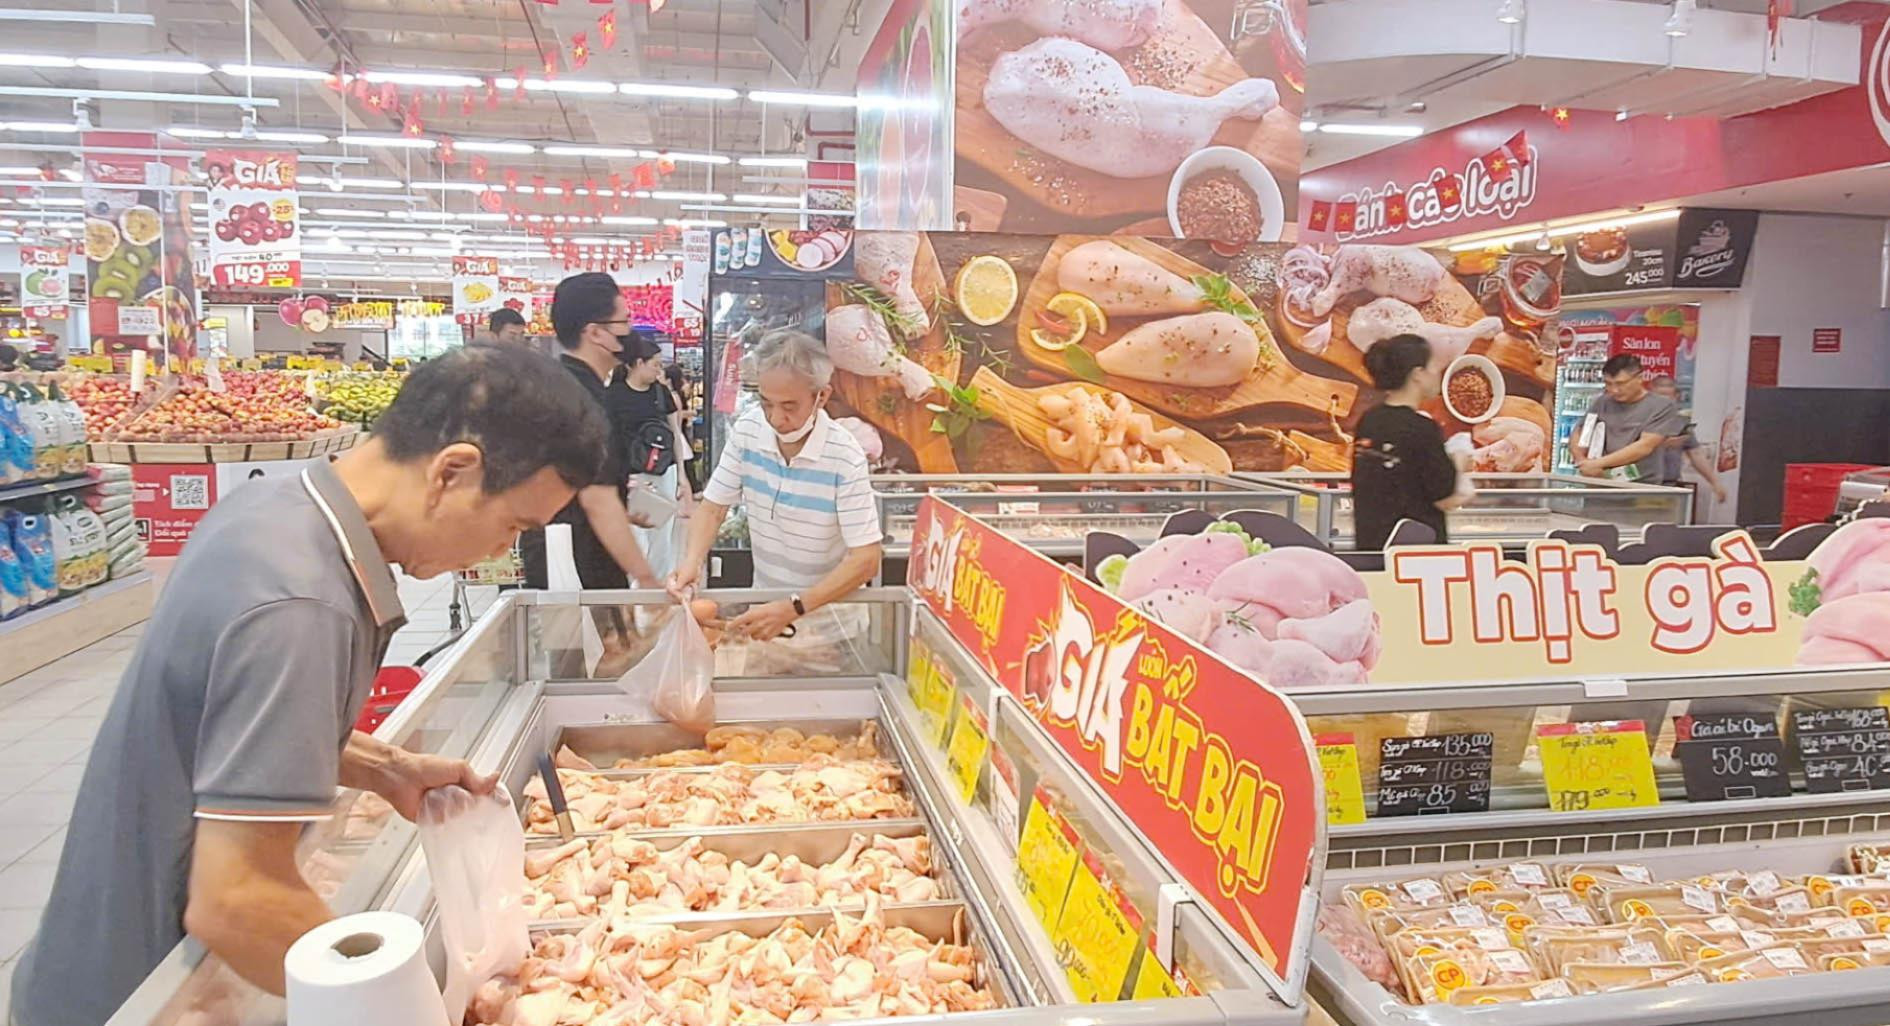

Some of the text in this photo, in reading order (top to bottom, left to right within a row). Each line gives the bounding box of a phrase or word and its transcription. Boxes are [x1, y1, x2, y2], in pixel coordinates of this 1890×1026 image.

[1337, 187, 1406, 233] án
[1408, 174, 1463, 223] cá
[1394, 536, 1777, 663] Thịt gà
[1050, 586, 1145, 774] GIÁ
[1126, 663, 1279, 886] BẤT BẠI
[1436, 968, 1460, 983] CP
